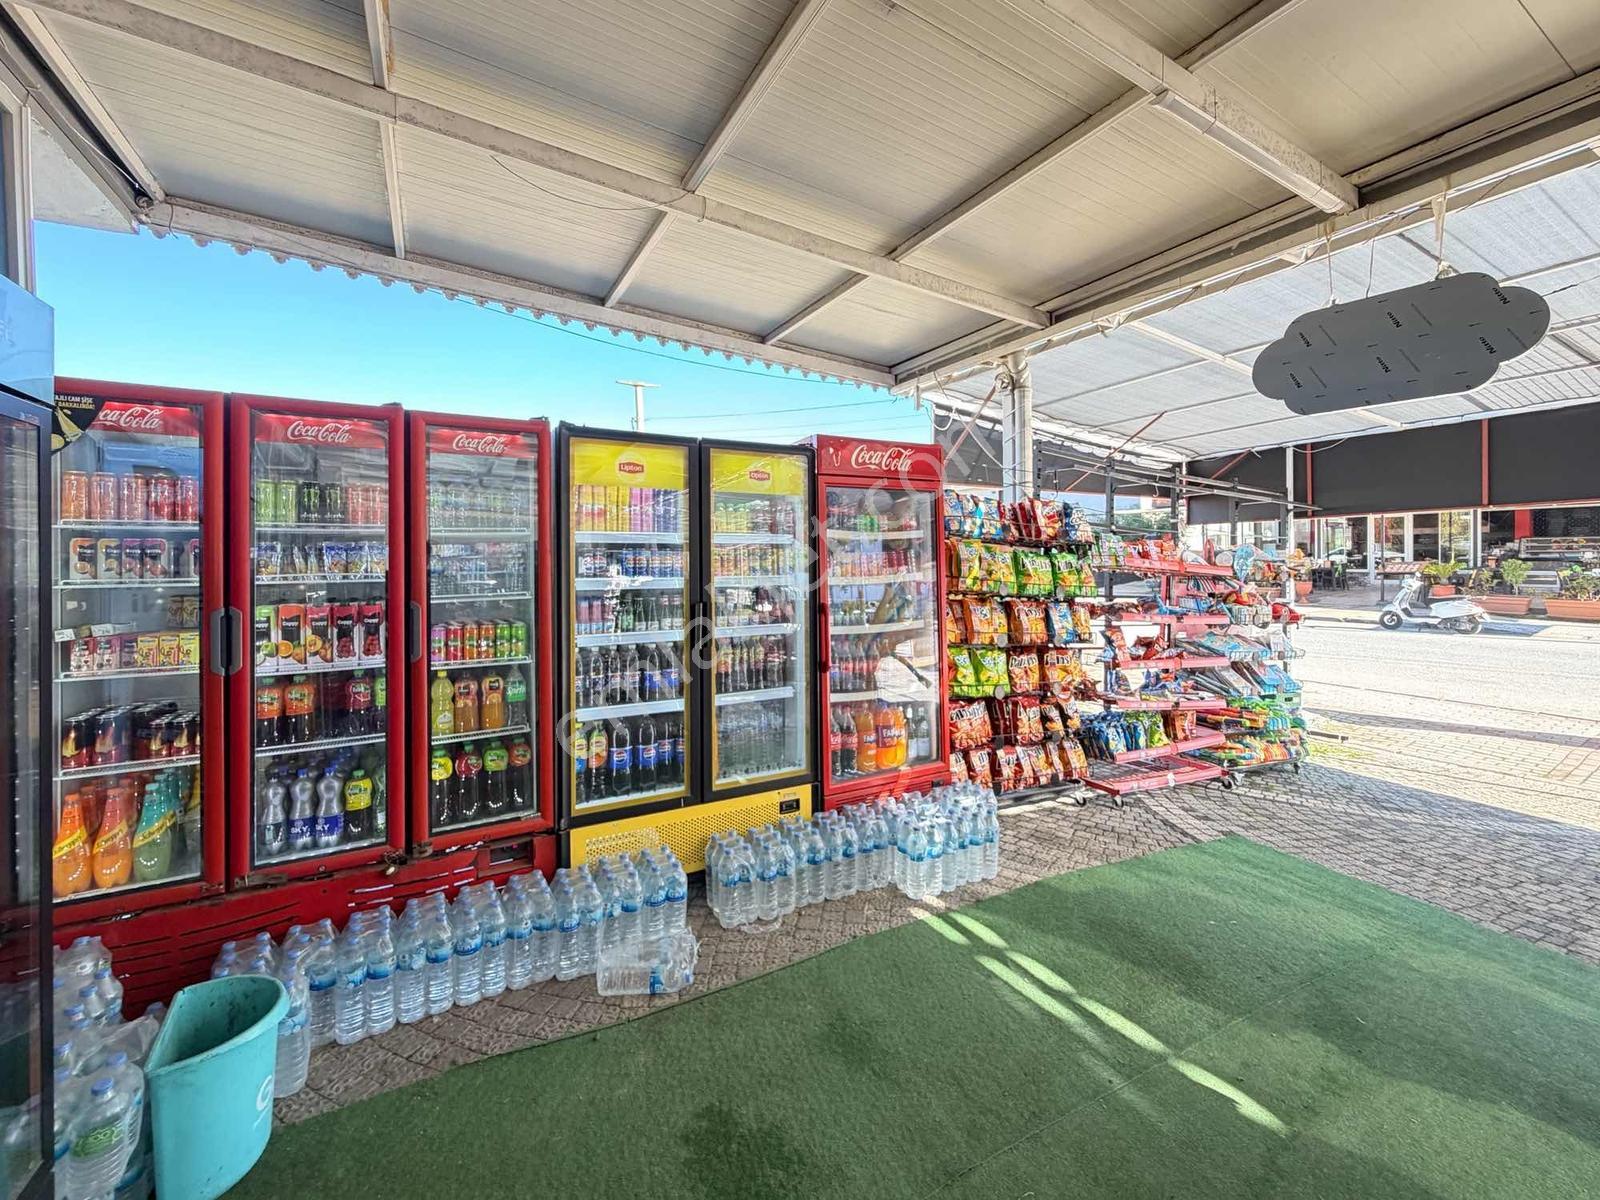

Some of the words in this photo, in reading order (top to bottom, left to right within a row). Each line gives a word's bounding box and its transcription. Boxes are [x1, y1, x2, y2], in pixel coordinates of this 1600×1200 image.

[1492, 287, 1511, 305] Nitto
[1387, 311, 1403, 329] Nitto
[1479, 336, 1497, 355] Nitto
[1376, 356, 1391, 374] Nitto
[93, 406, 164, 430] ca-Cola
[287, 420, 353, 444] Coca-Cola
[452, 433, 509, 455] Coca-Cola
[851, 444, 914, 472] Coca-Cola
[620, 464, 643, 473] Lipton
[506, 686, 526, 697] Sprit
[290, 826, 309, 834] SKY
